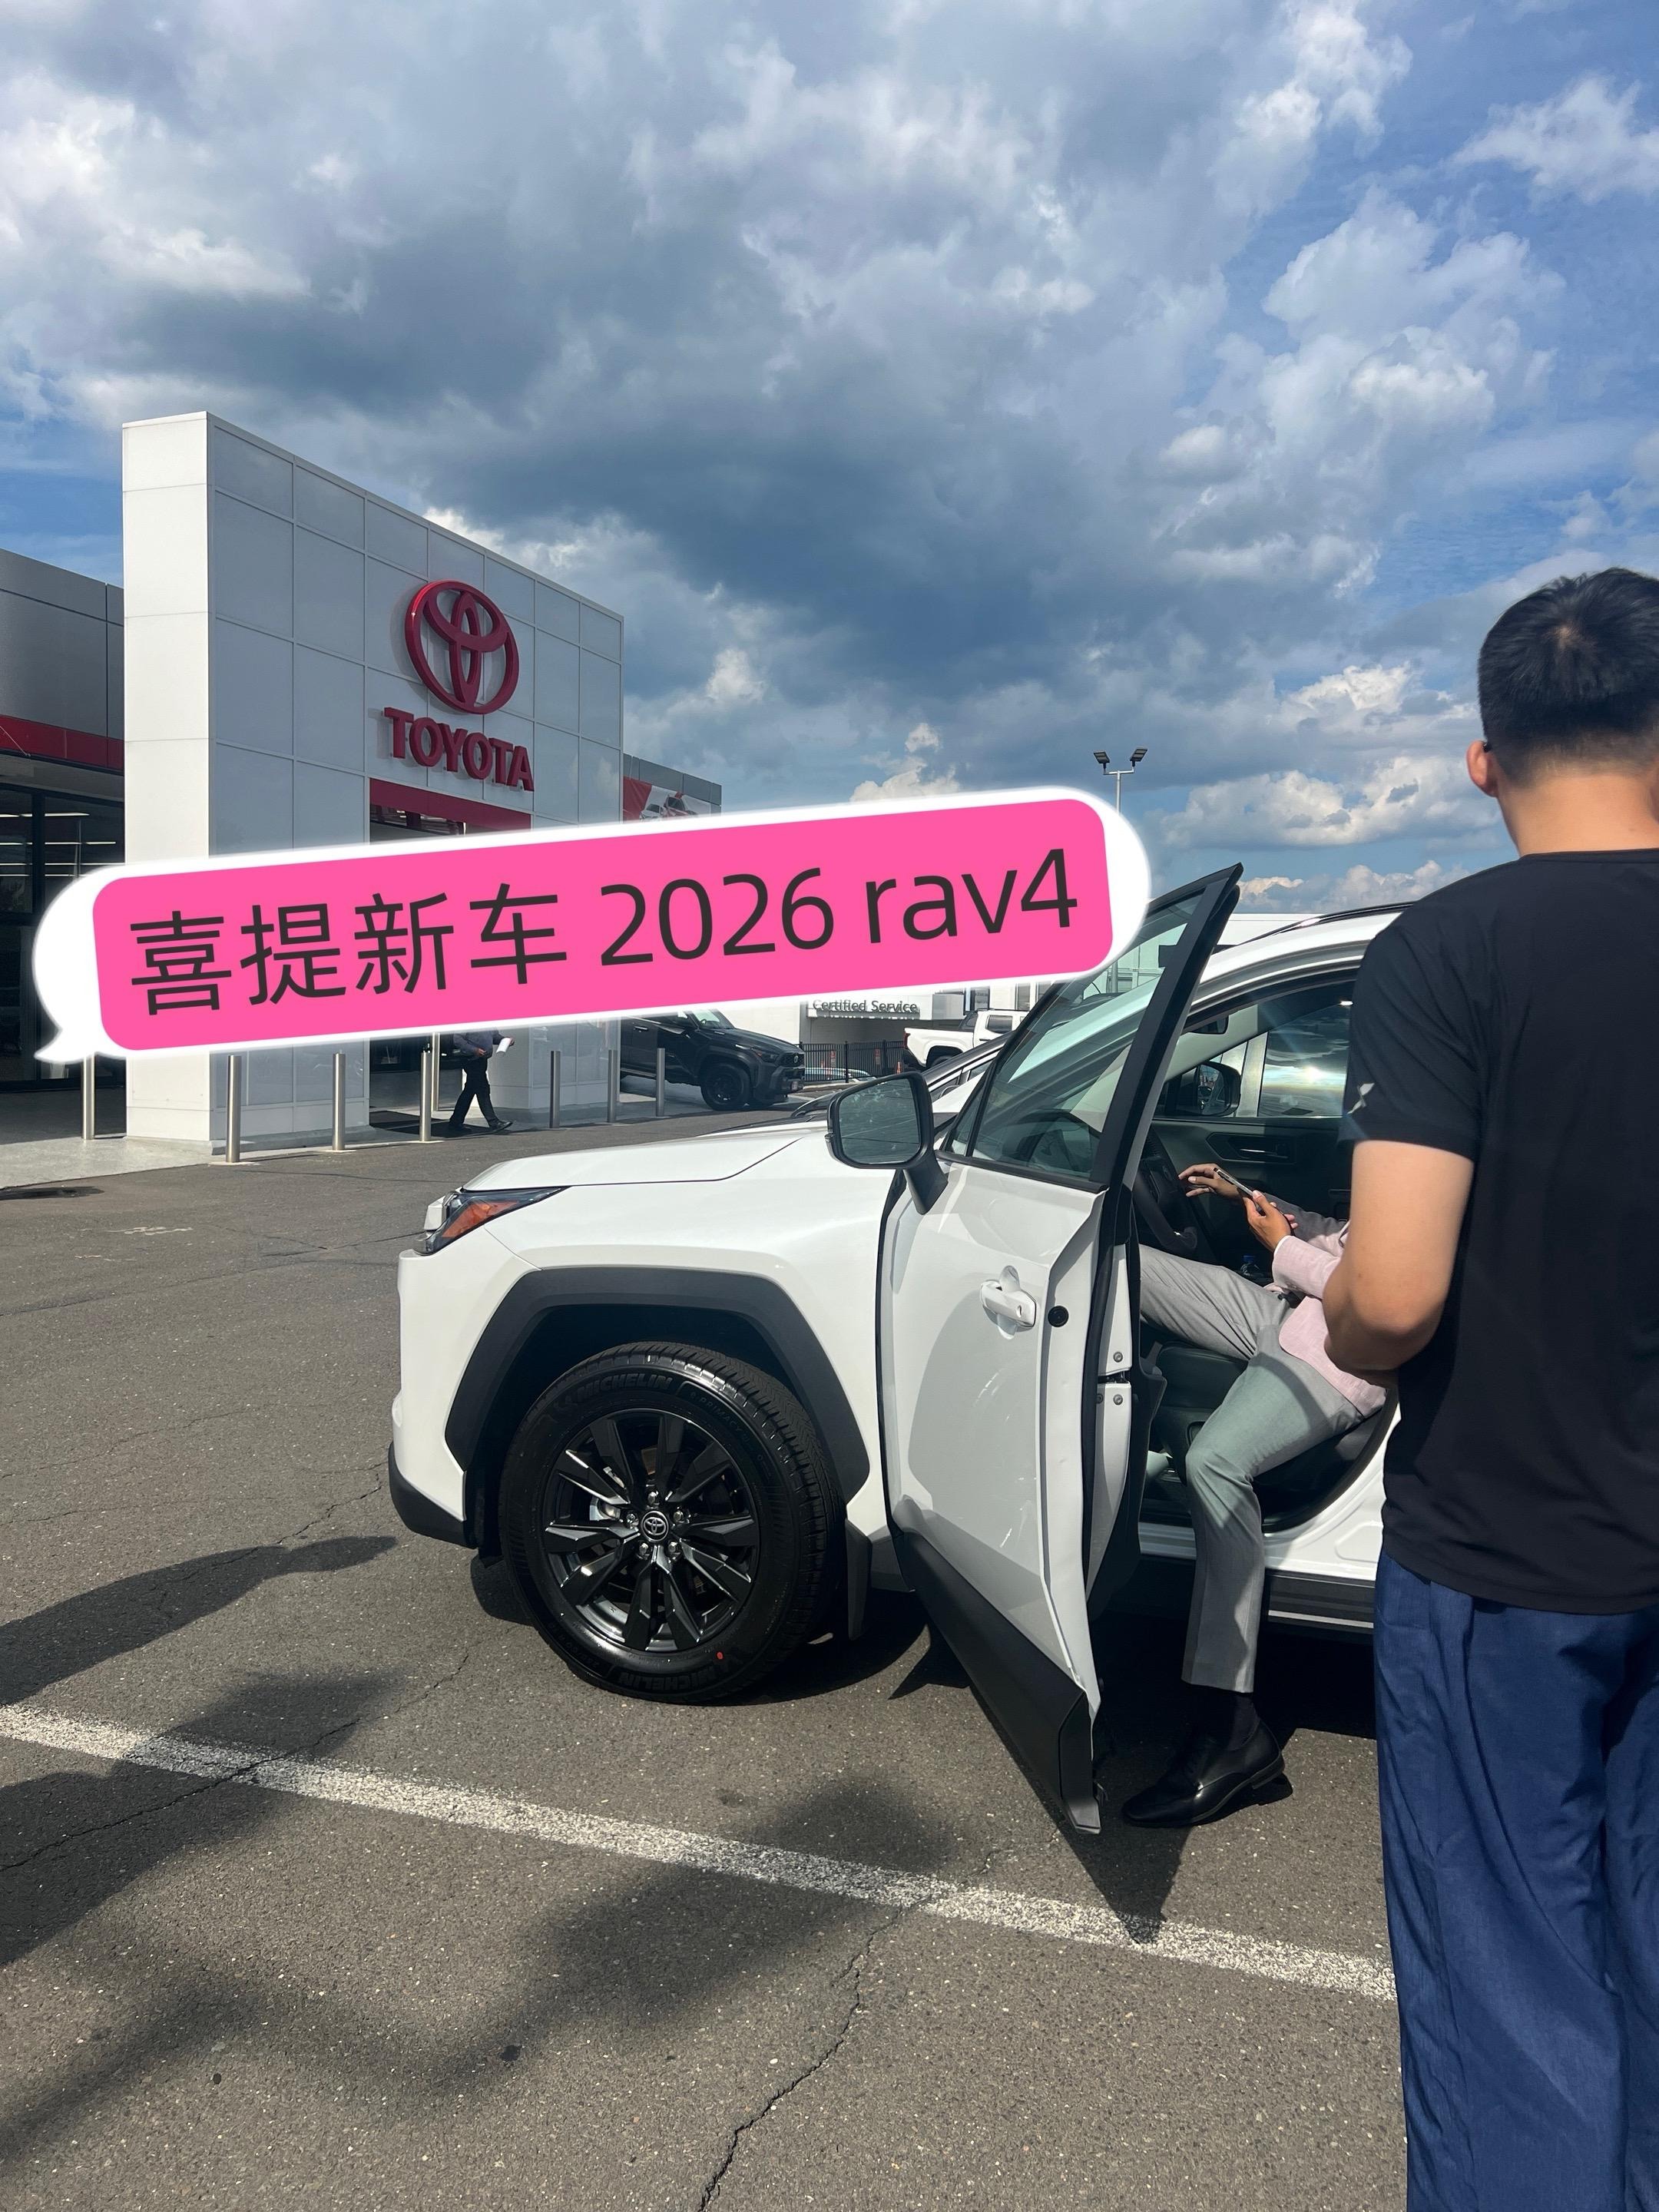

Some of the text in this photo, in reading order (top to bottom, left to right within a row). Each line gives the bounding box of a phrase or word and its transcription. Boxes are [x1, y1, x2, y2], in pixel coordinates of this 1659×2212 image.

[383, 707, 535, 792] TOYOTA
[813, 999, 918, 1012] Certified Service
[578, 1373, 673, 1401] MICHELIN
